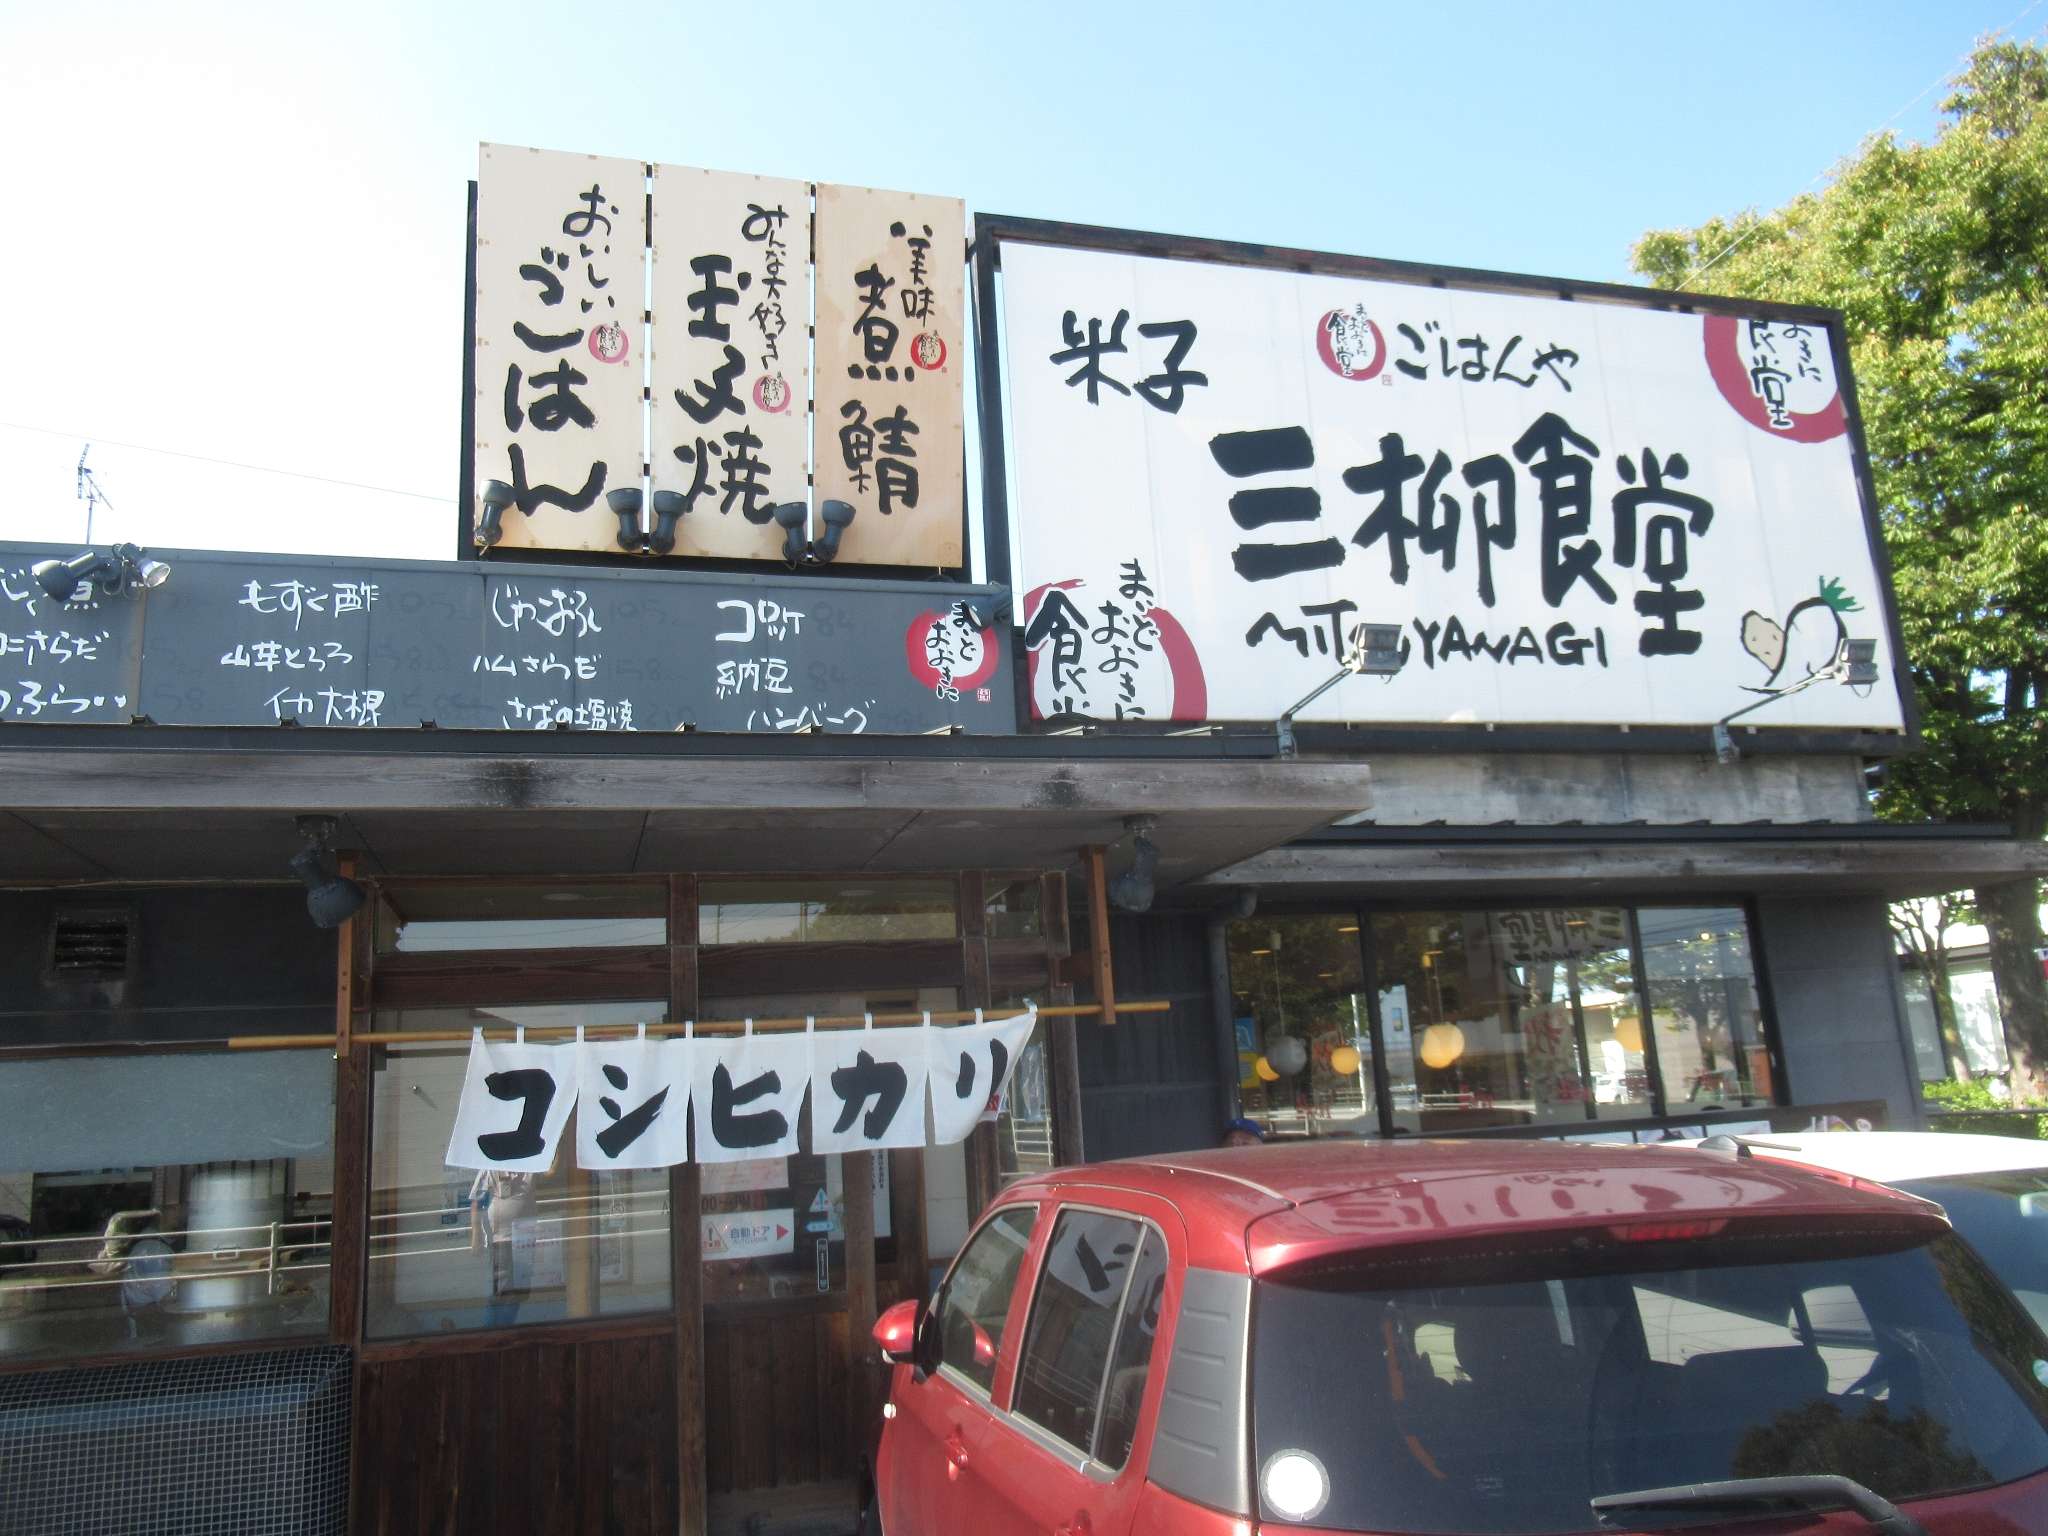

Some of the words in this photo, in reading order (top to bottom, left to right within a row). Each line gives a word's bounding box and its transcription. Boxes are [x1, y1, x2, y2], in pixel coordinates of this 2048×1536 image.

[564, 184, 619, 312] おいしい
[742, 203, 789, 369] みんな大好き
[890, 221, 935, 326] 美味
[504, 246, 607, 517] ごはん
[674, 255, 777, 525] 玉子焼
[839, 263, 920, 515] 煮鯖
[1049, 309, 1208, 414] 米子
[1394, 320, 1579, 391] ごはんや
[1208, 412, 1714, 657] 三柳食堂
[239, 579, 380, 631] もずく酢
[715, 599, 806, 642] コロッケ
[1119, 558, 1154, 651] まいど
[1245, 599, 1608, 670] MITYANAGI
[221, 640, 353, 672] 山芋とろろ
[716, 658, 793, 699] 納豆
[264, 685, 385, 727] イカ大根
[747, 699, 876, 734] ハンバーグ
[477, 1038, 1008, 1160] コシヒカリ
